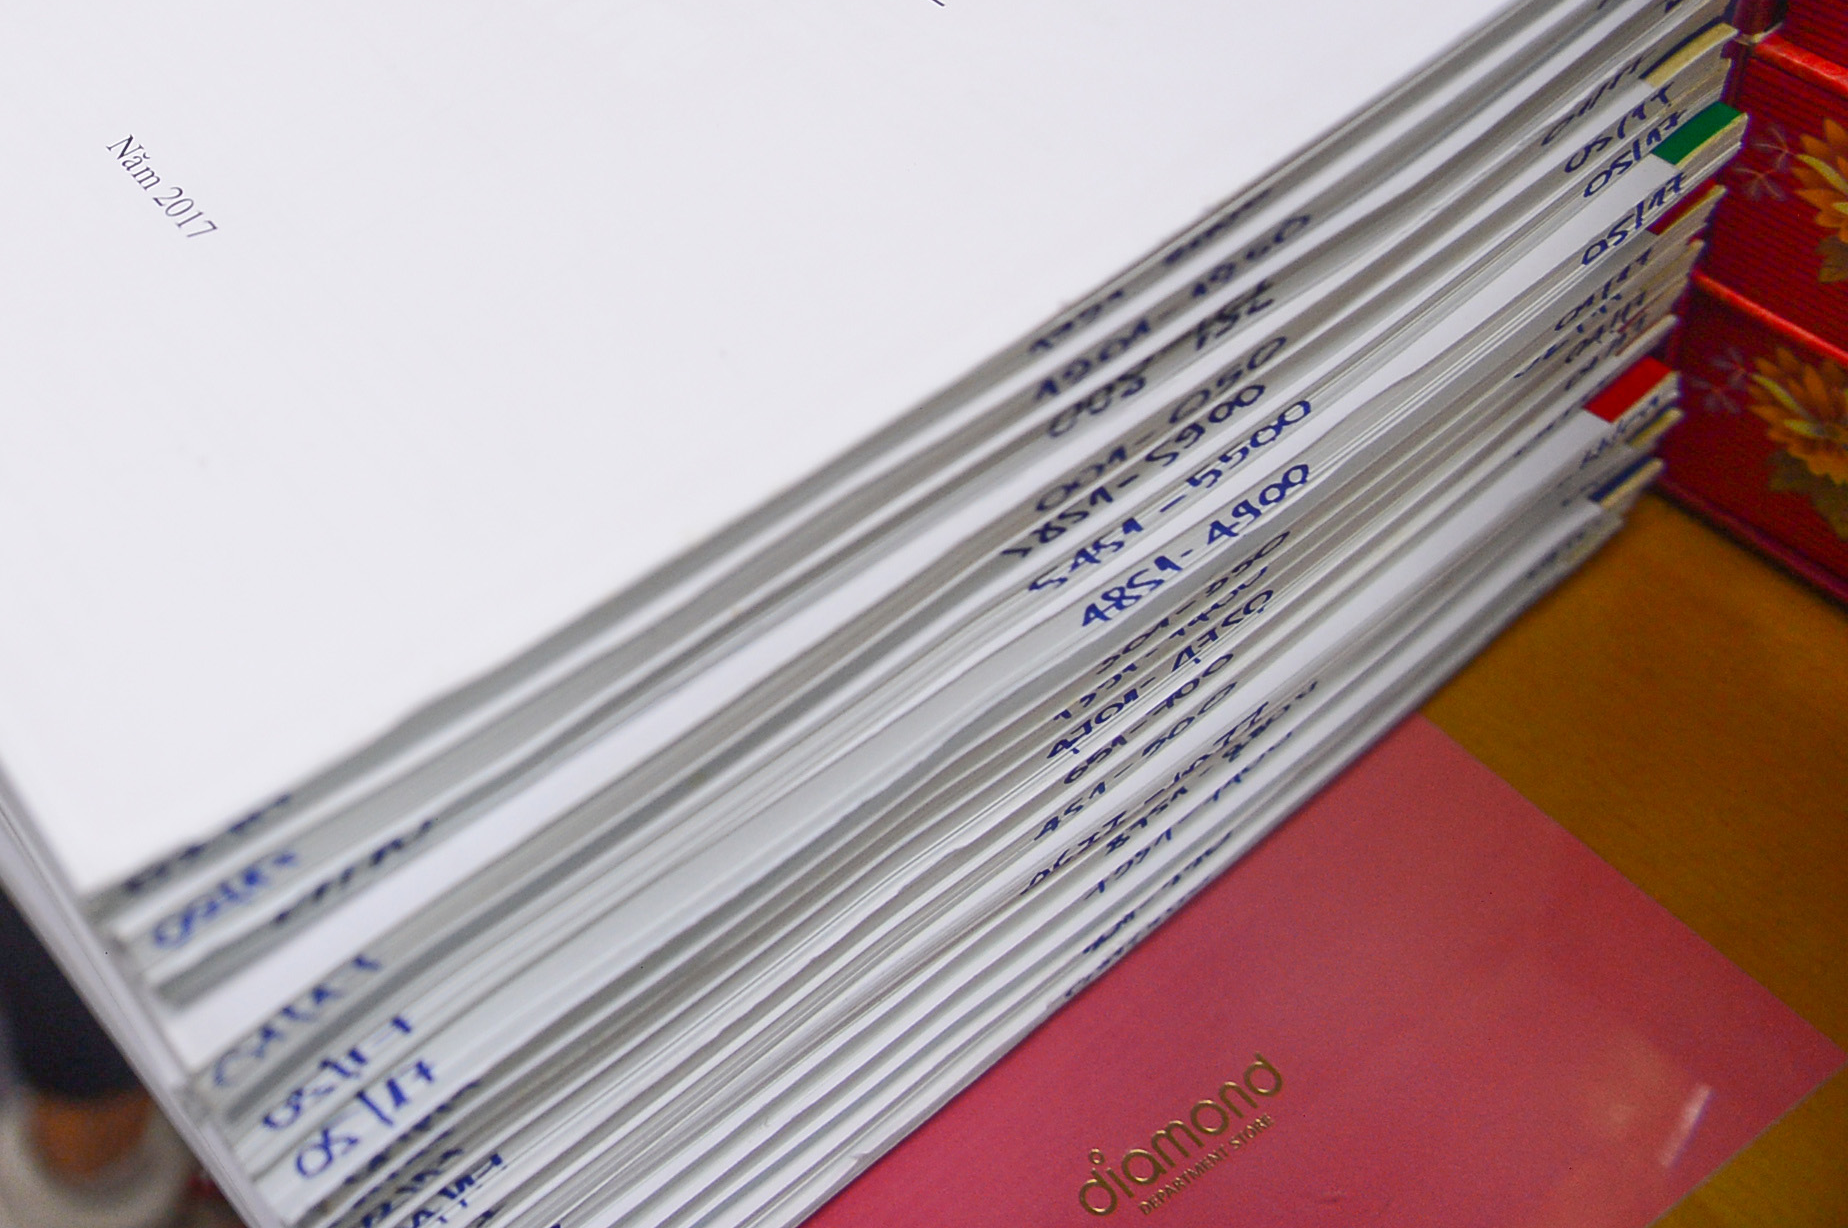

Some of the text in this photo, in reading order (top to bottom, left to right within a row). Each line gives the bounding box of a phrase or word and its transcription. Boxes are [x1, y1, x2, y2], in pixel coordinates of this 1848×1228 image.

[105, 133, 219, 239] Năm 2017
[1186, 400, 1312, 489] 5500
[1082, 554, 1184, 627] 4851
[1207, 463, 1311, 546] 4900
[1078, 1050, 1284, 1217] diamond
[1138, 1113, 1274, 1216] DEPARTMENT STORE
